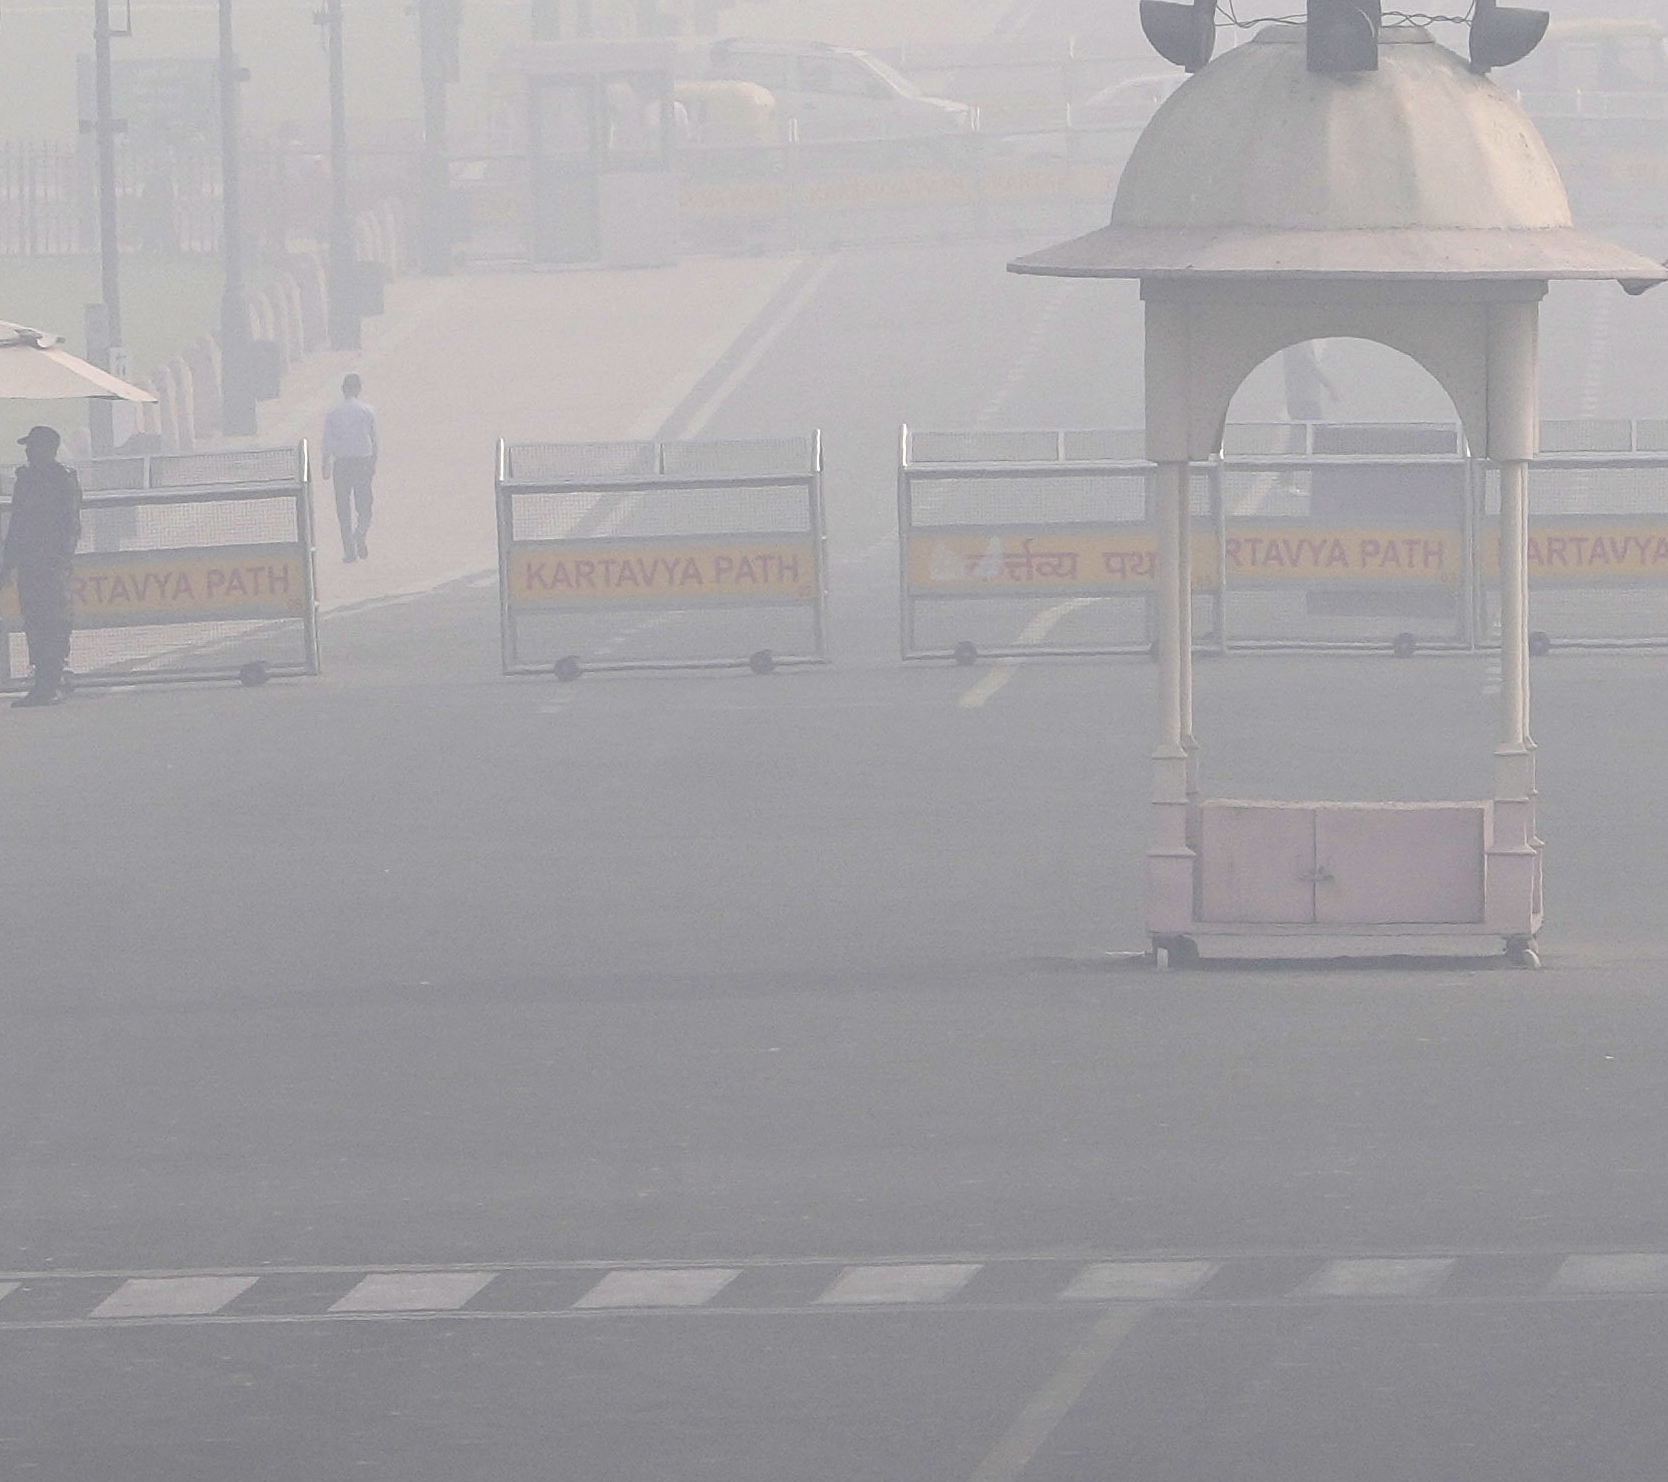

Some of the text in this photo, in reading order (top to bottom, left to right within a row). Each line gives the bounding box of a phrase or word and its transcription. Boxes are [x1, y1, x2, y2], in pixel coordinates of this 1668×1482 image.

[1103, 551, 1158, 581] पथ
[1225, 537, 1445, 569] RTAVYA PATH
[70, 563, 291, 605] RTAVYA PATH
[525, 553, 800, 591] KARTAVYA PATH
